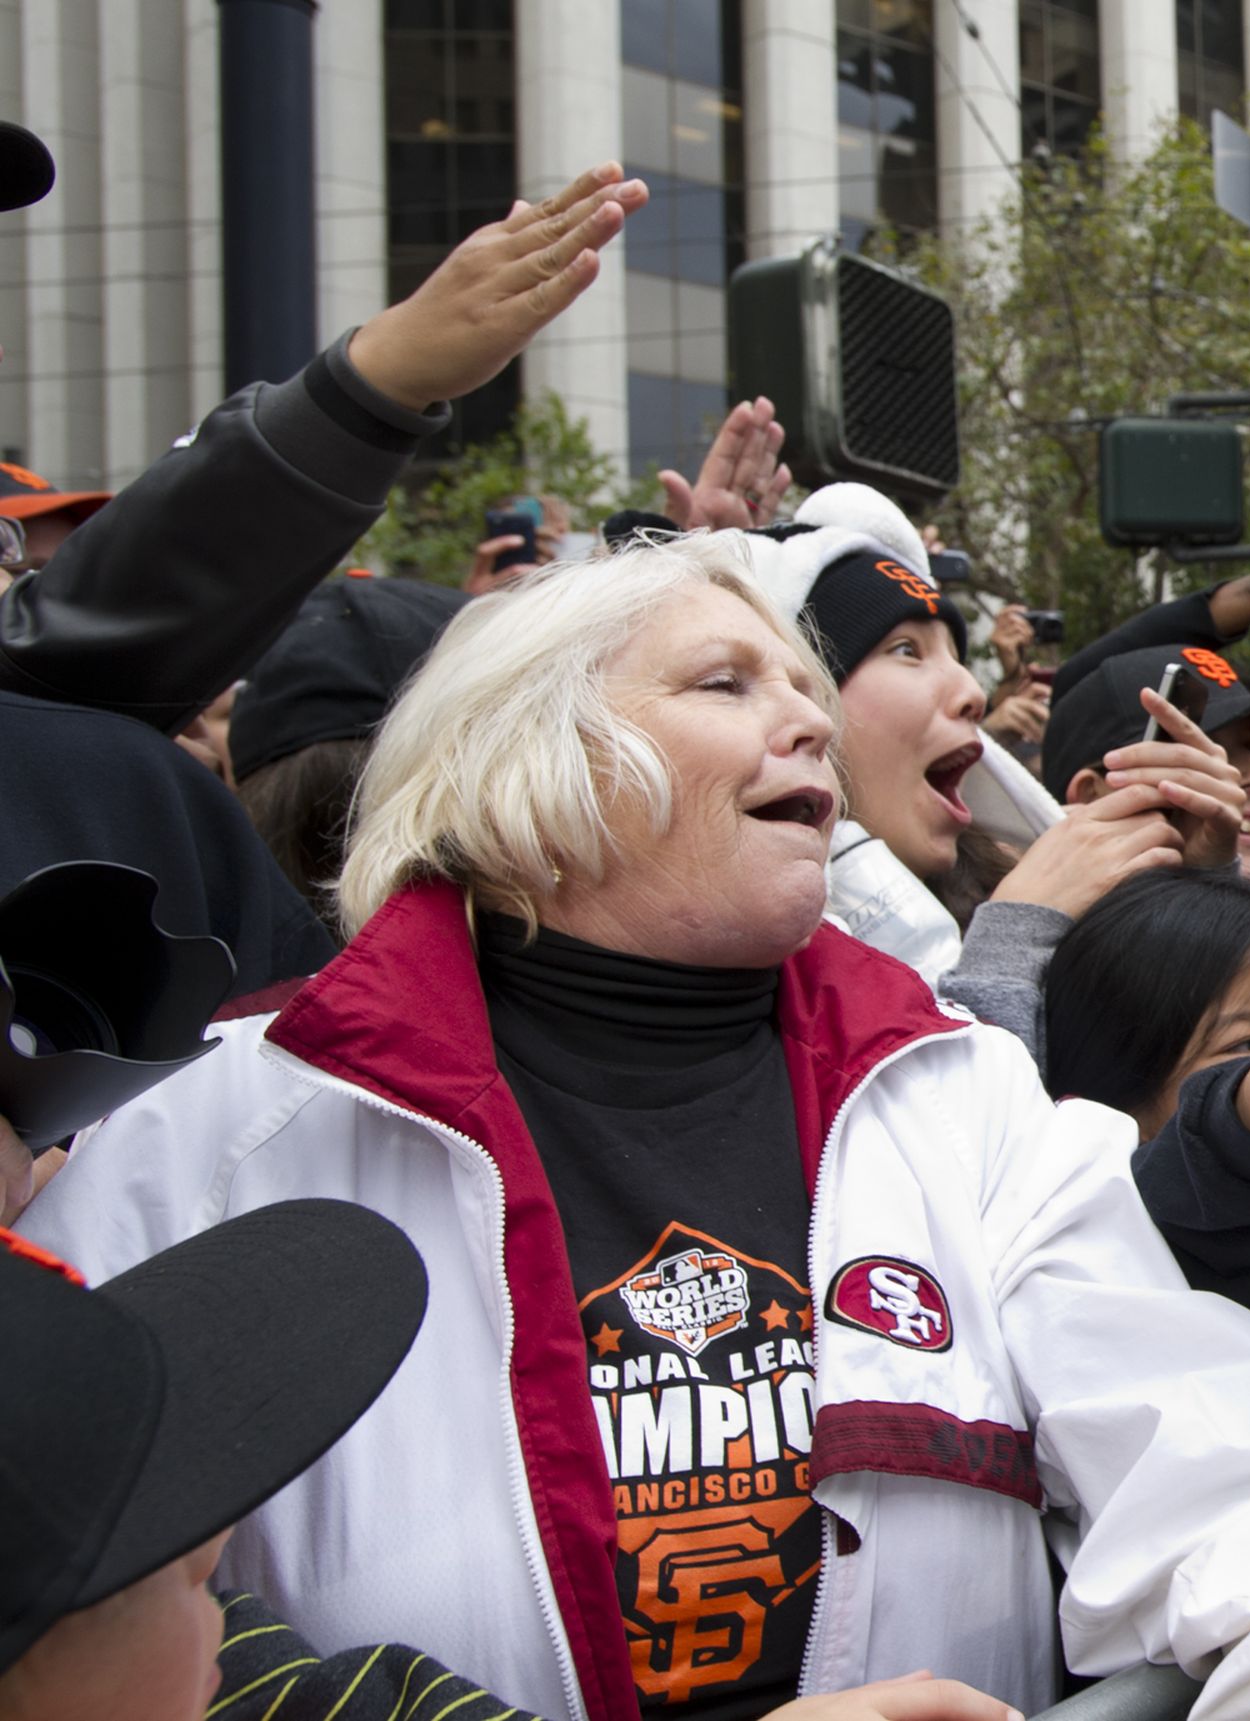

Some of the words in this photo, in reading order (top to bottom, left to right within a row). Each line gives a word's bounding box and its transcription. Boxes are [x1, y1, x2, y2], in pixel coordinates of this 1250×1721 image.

[625, 1269, 743, 1309] WORLD
[633, 1288, 746, 1327] SERIES
[868, 1266, 943, 1344] SF
[590, 1352, 709, 1390] ONAL
[627, 1521, 787, 1704] SF
